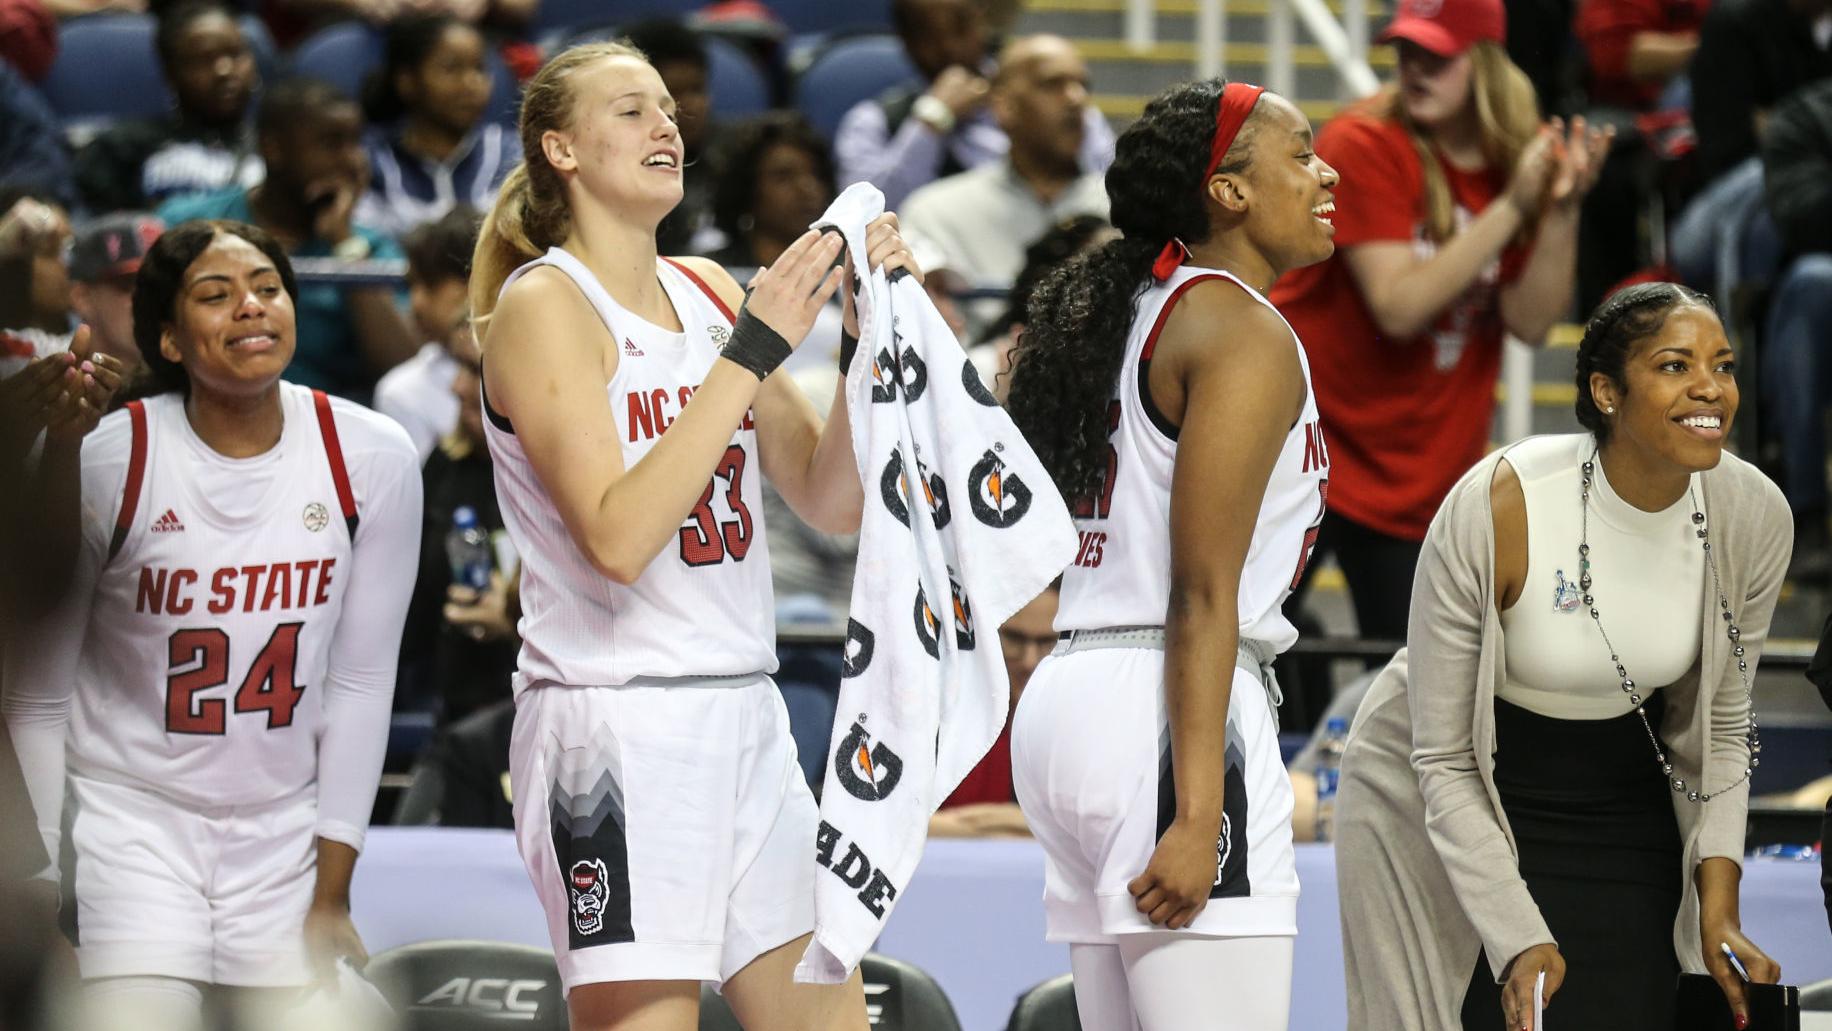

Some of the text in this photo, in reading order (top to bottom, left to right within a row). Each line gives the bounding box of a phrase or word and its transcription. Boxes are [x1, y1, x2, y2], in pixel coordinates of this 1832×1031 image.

[627, 388, 675, 443] NC
[679, 444, 753, 567] 33
[136, 557, 337, 616] NC STATE
[165, 621, 307, 736] 24
[417, 977, 547, 1012] ACC
